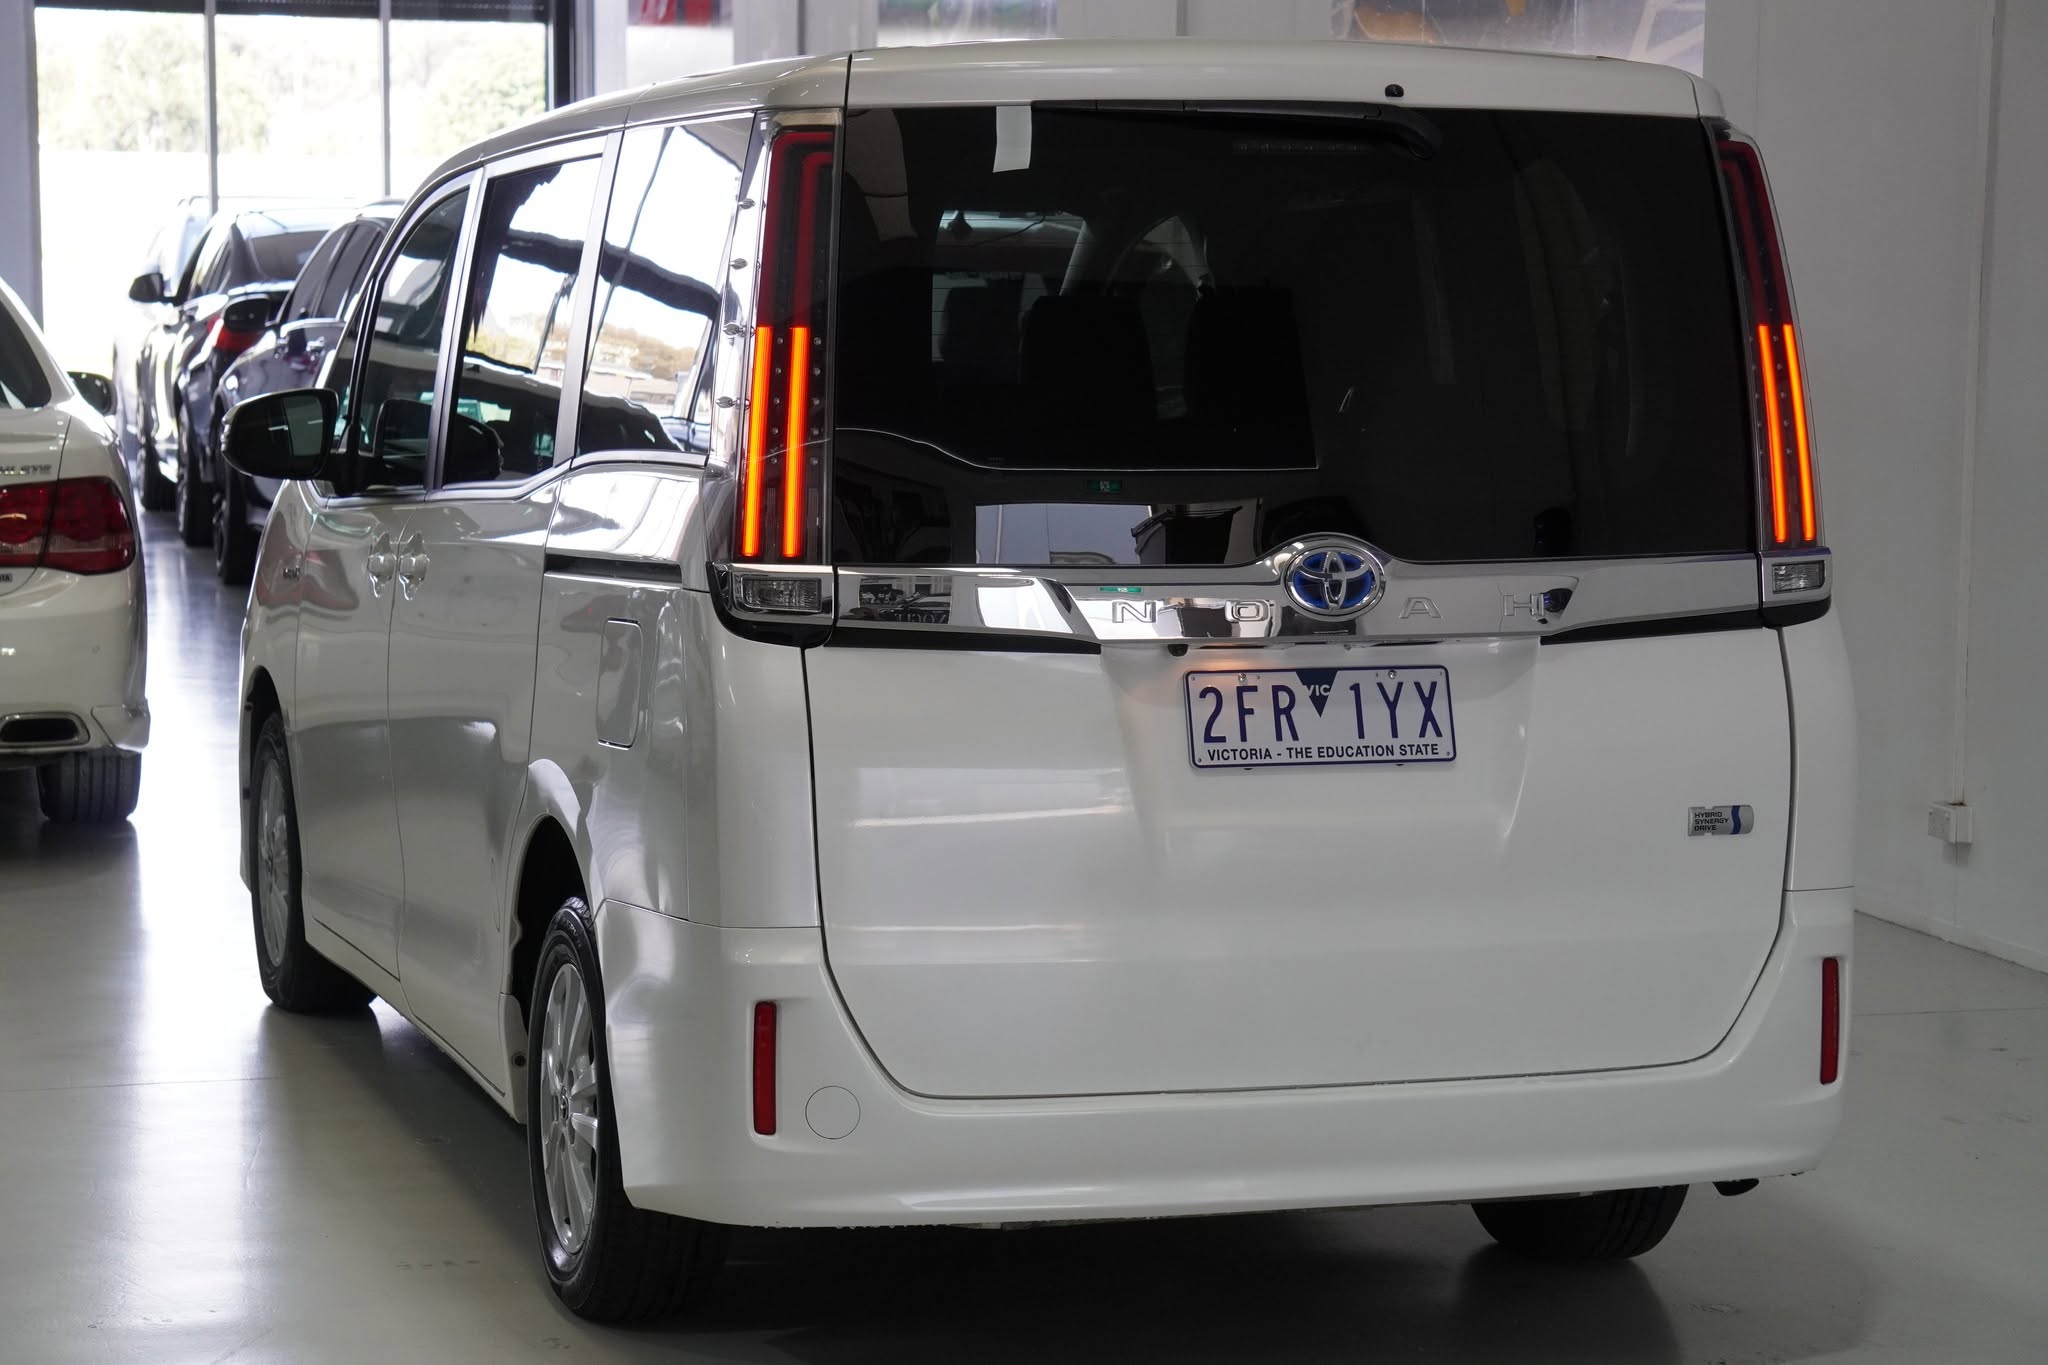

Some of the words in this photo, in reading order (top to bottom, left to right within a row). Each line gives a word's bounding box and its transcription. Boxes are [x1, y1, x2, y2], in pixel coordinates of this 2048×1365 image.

[1112, 594, 1545, 623] NOAH
[1303, 684, 1331, 697] VIC
[1199, 685, 1299, 743] 2FR
[1349, 681, 1443, 739] 1YX
[1207, 747, 1273, 761] VICTORIA
[1286, 746, 1313, 759] THE
[1317, 744, 1395, 759] EDUCATION
[1399, 743, 1440, 756] STATE
